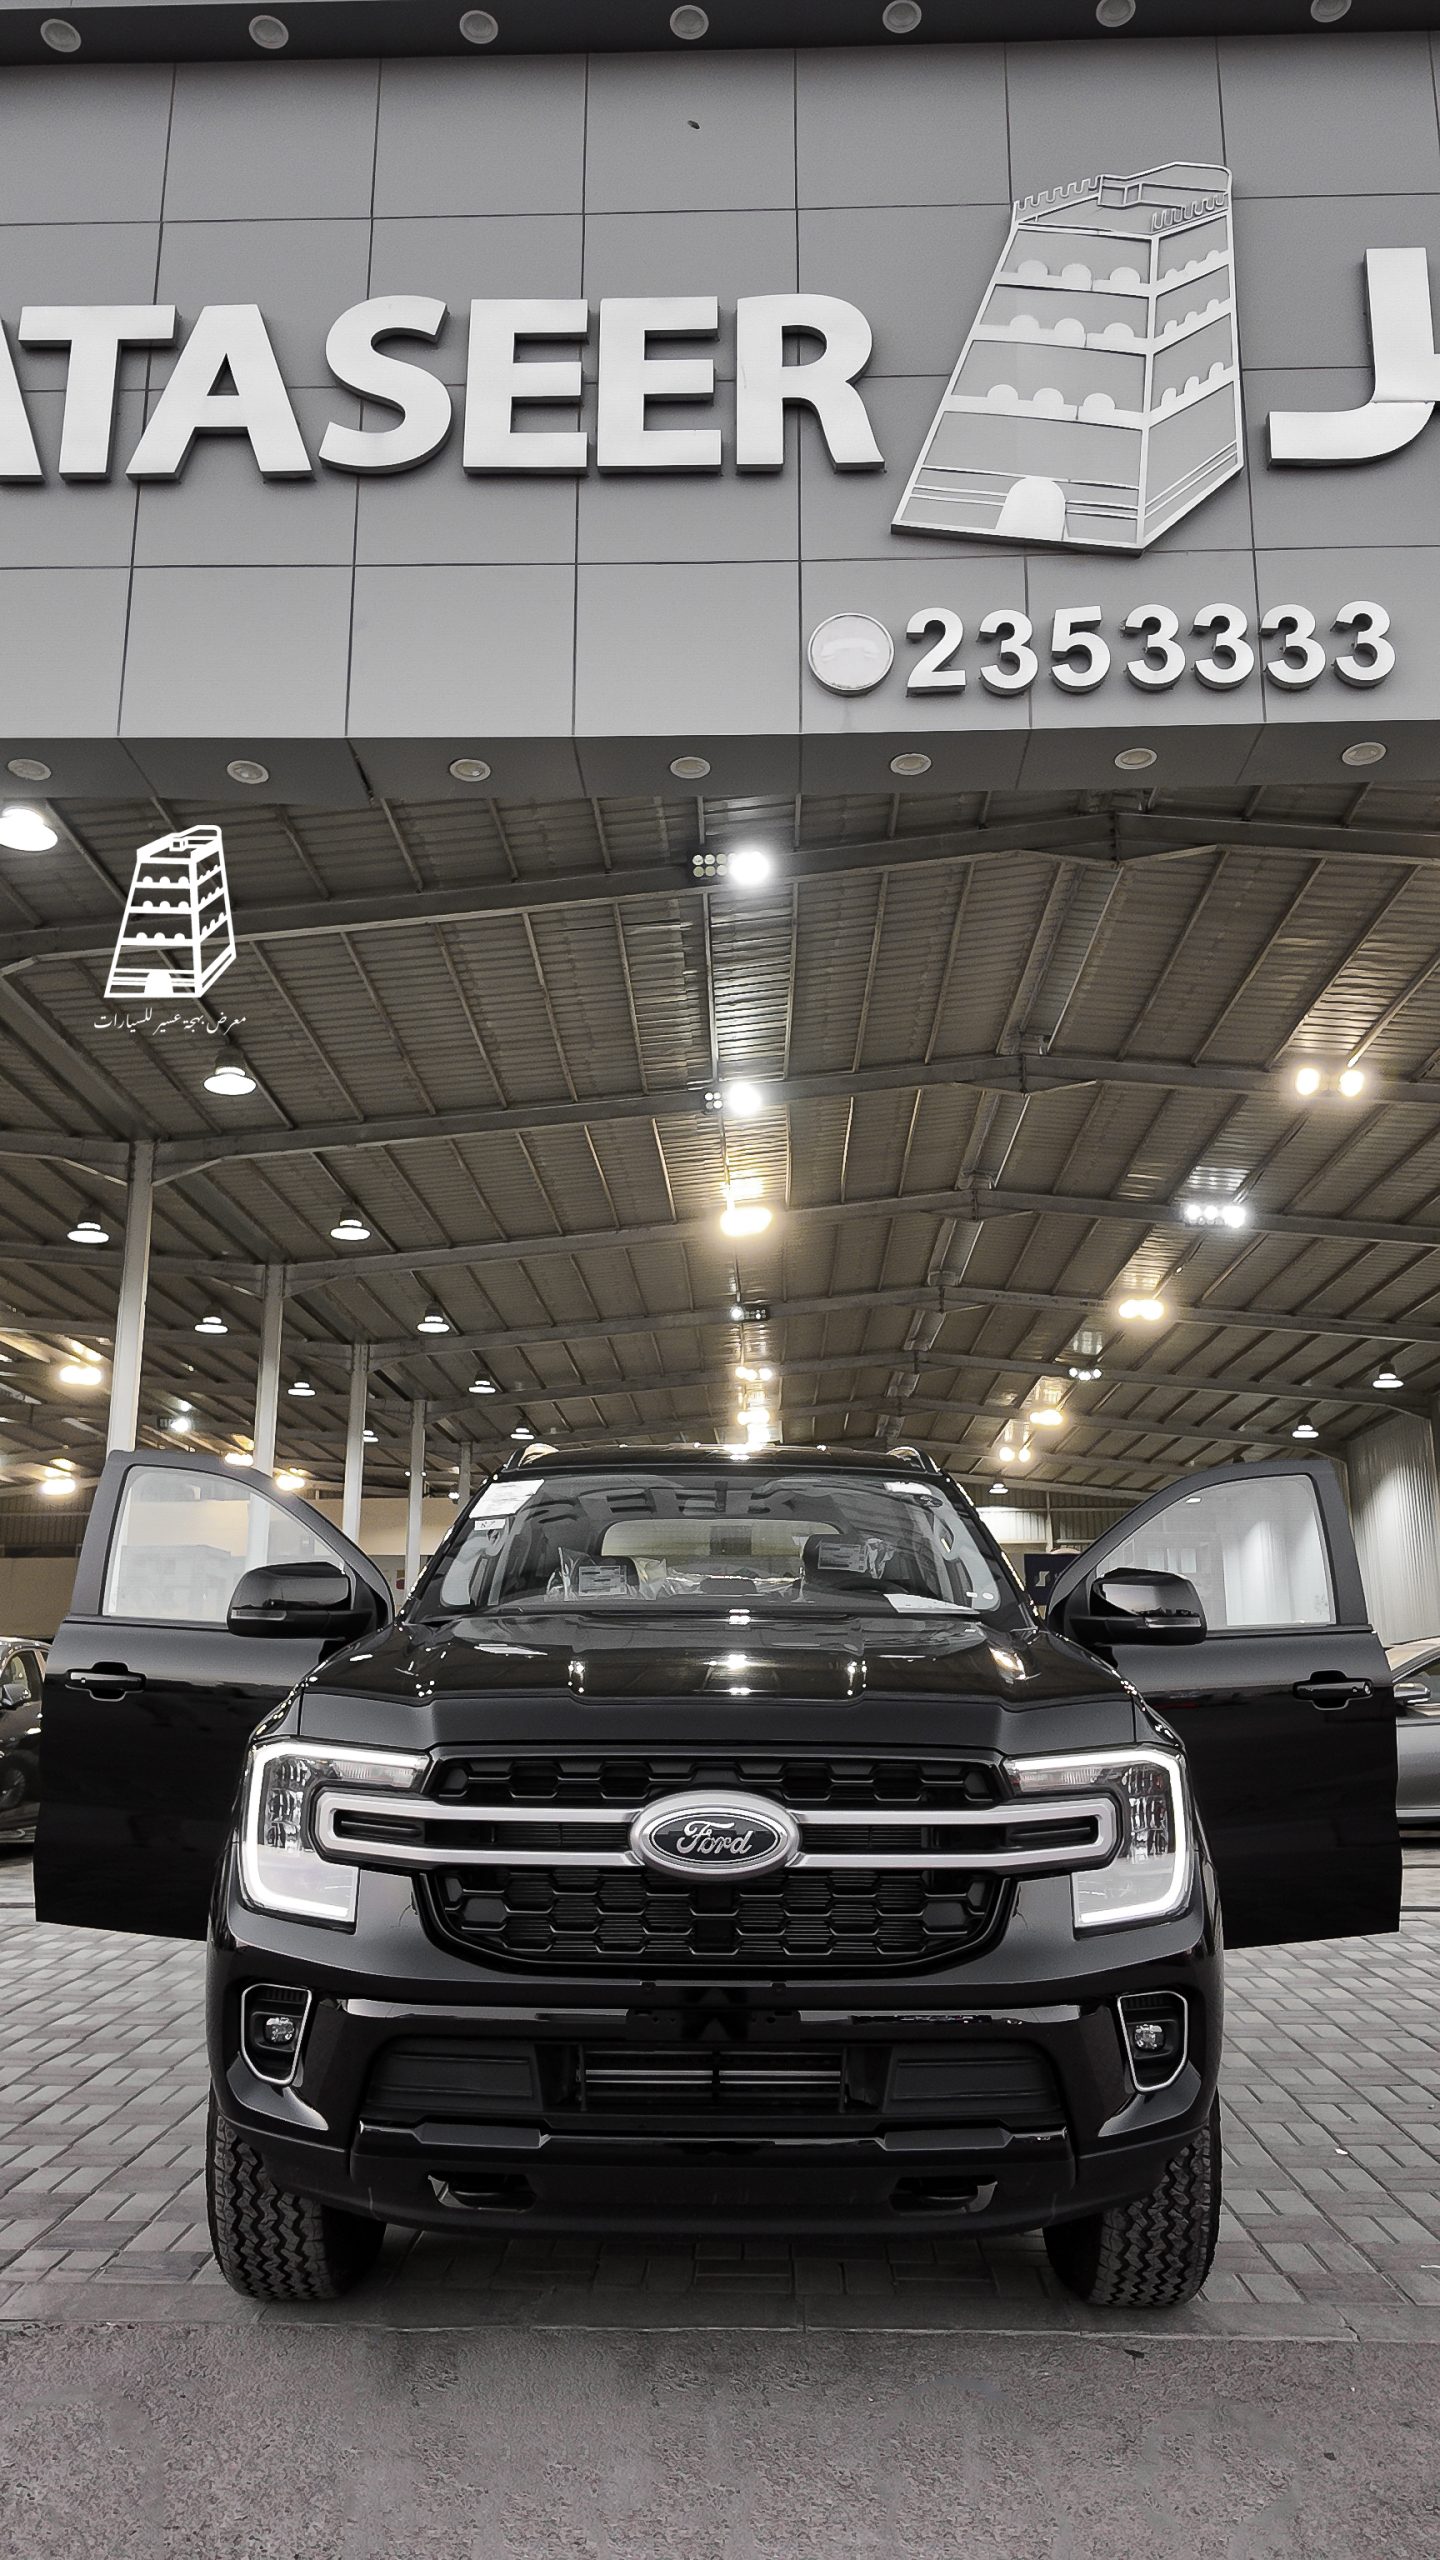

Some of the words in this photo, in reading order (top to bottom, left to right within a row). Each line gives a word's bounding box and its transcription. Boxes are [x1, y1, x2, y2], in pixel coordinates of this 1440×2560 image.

[0, 294, 886, 482] TASEER
[905, 600, 1397, 695] 2353333
[676, 1820, 754, 1855] Ford
